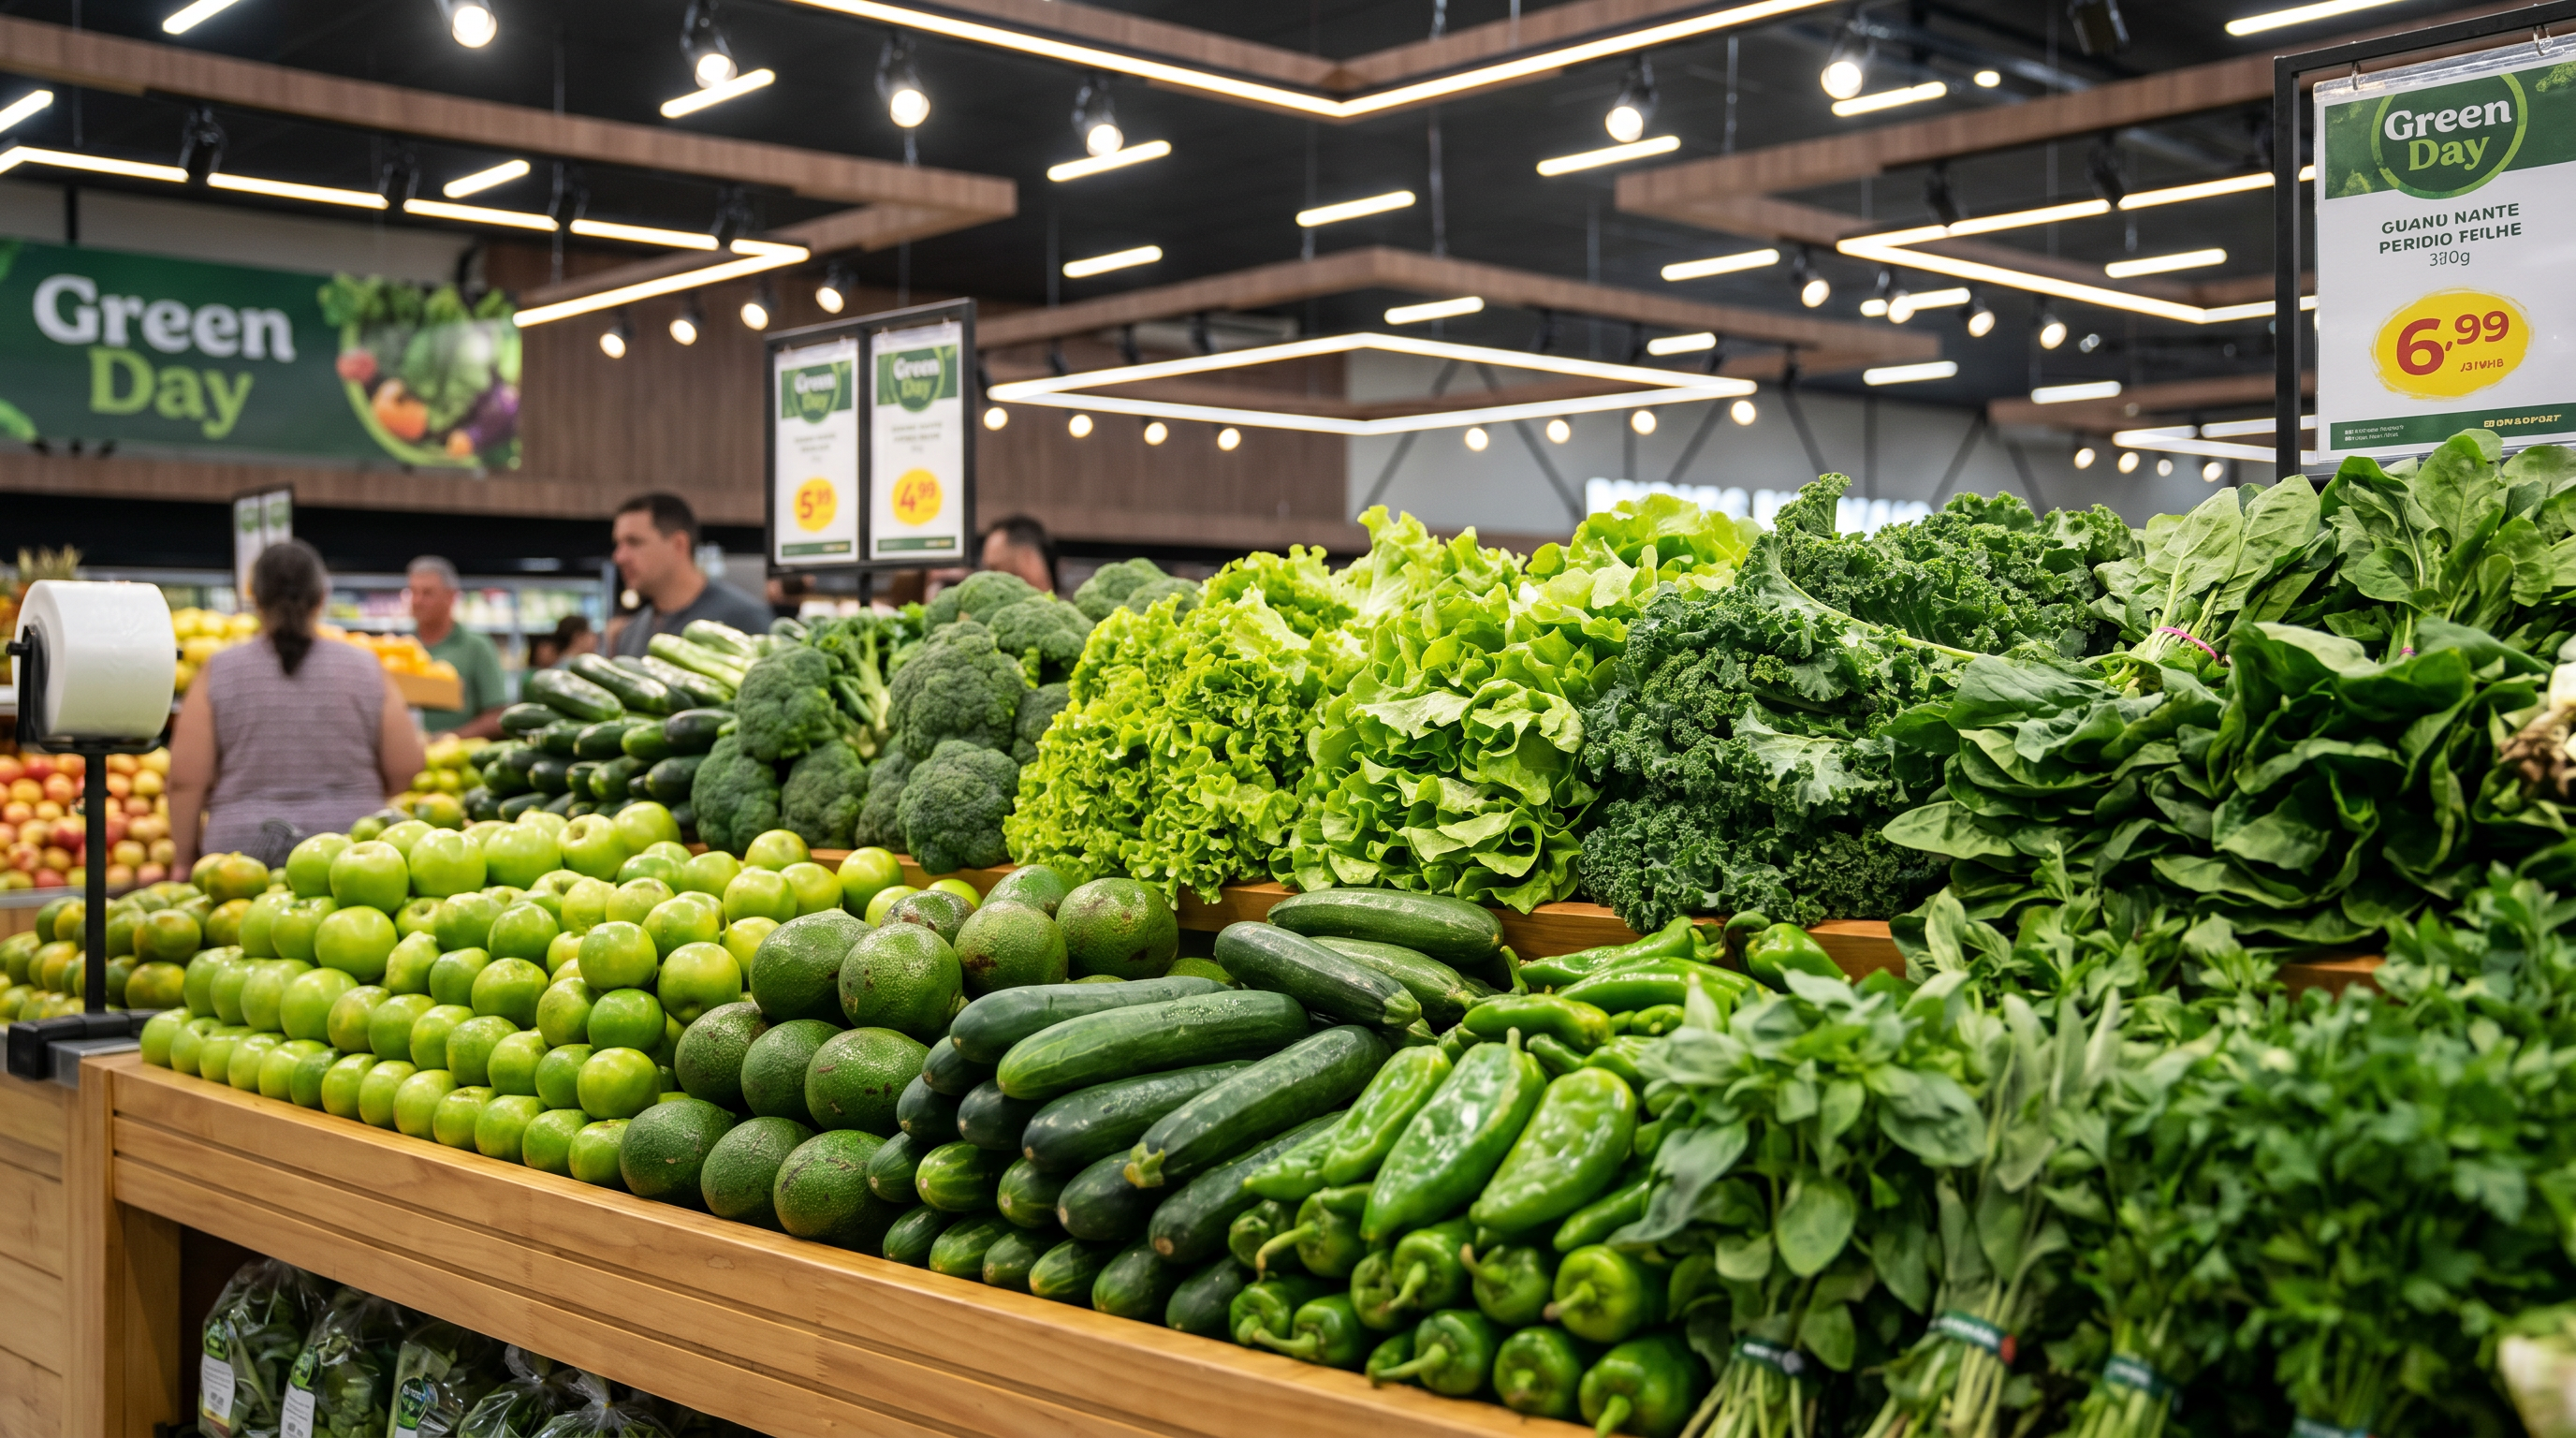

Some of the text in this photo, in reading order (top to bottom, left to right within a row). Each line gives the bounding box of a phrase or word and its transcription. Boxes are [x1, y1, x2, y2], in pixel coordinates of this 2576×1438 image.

[2384, 100, 2512, 140] Green
[2408, 137, 2490, 170] Day
[2454, 202, 2519, 224] NANTE
[2379, 232, 2452, 254] PERIDIO
[32, 272, 297, 363] Green
[2396, 310, 2510, 375] 6,99
[892, 357, 941, 380] Green
[88, 345, 254, 440] Day
